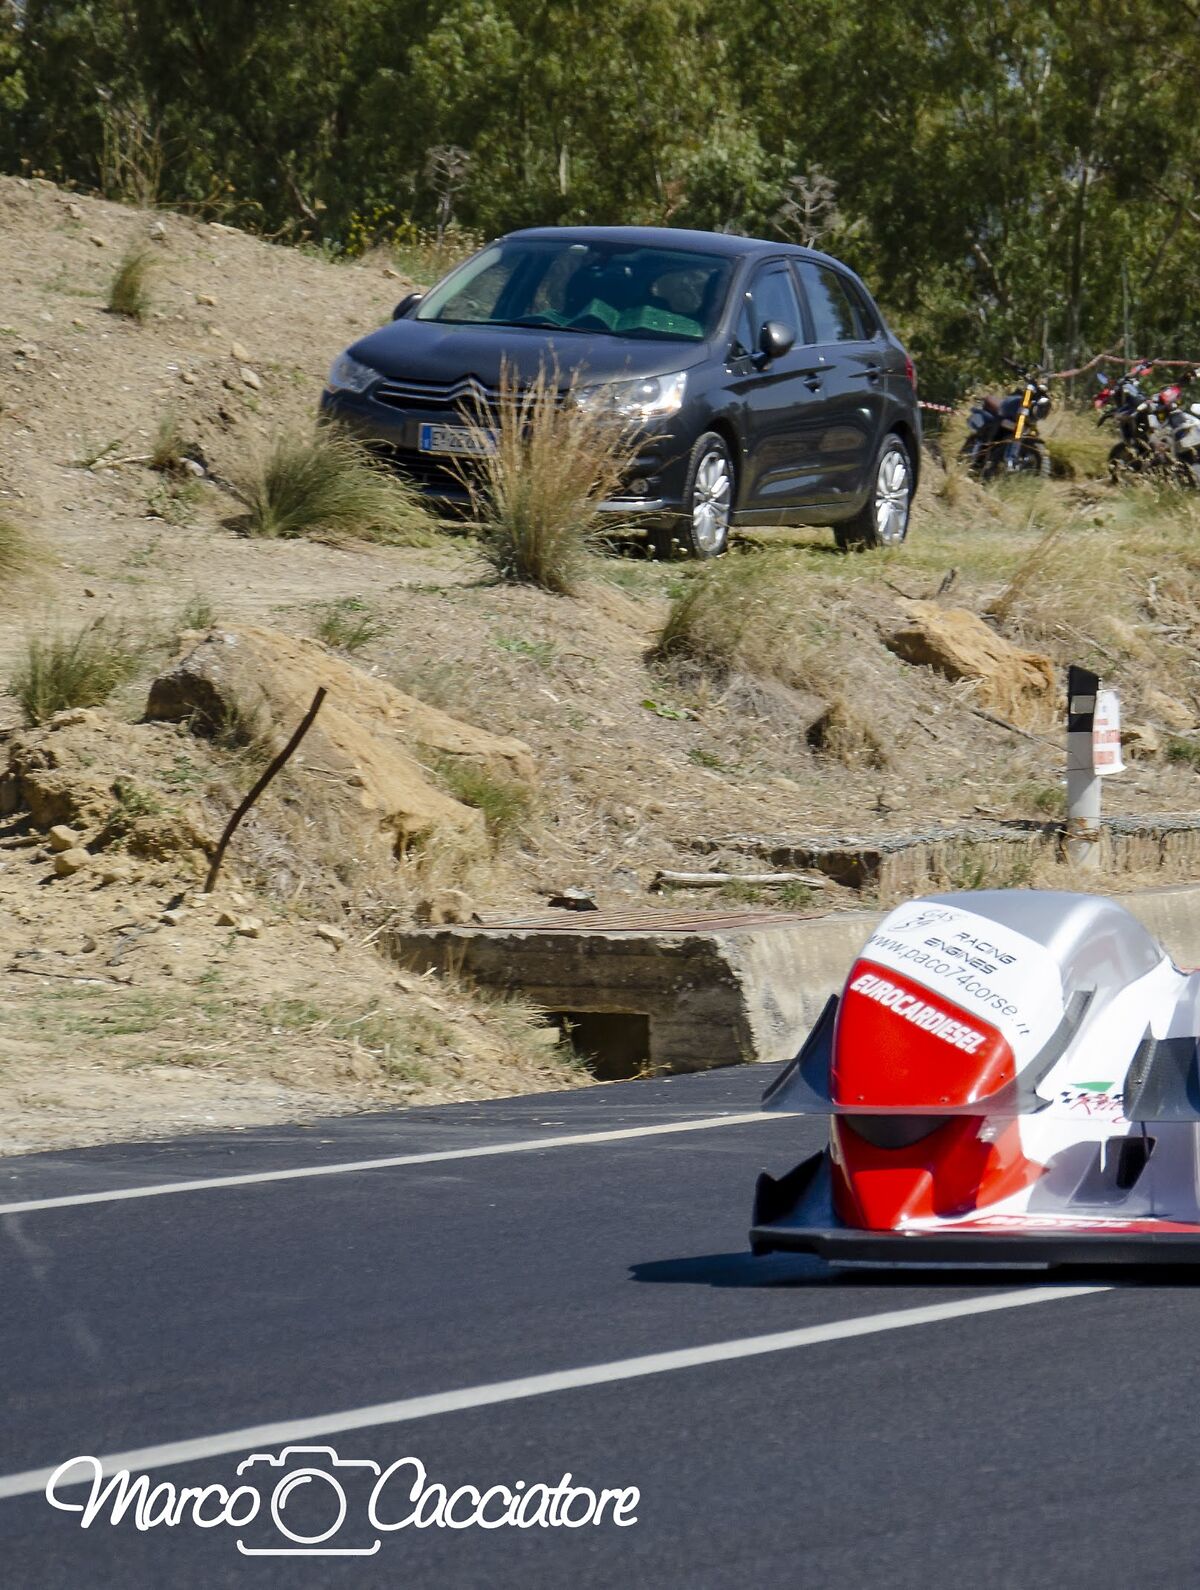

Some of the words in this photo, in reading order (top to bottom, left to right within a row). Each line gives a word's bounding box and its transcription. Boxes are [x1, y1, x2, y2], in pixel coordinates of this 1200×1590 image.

[923, 937, 998, 974] ENGINES
[952, 932, 1017, 965] RACING
[850, 974, 987, 1055] EUROCARDIESEL
